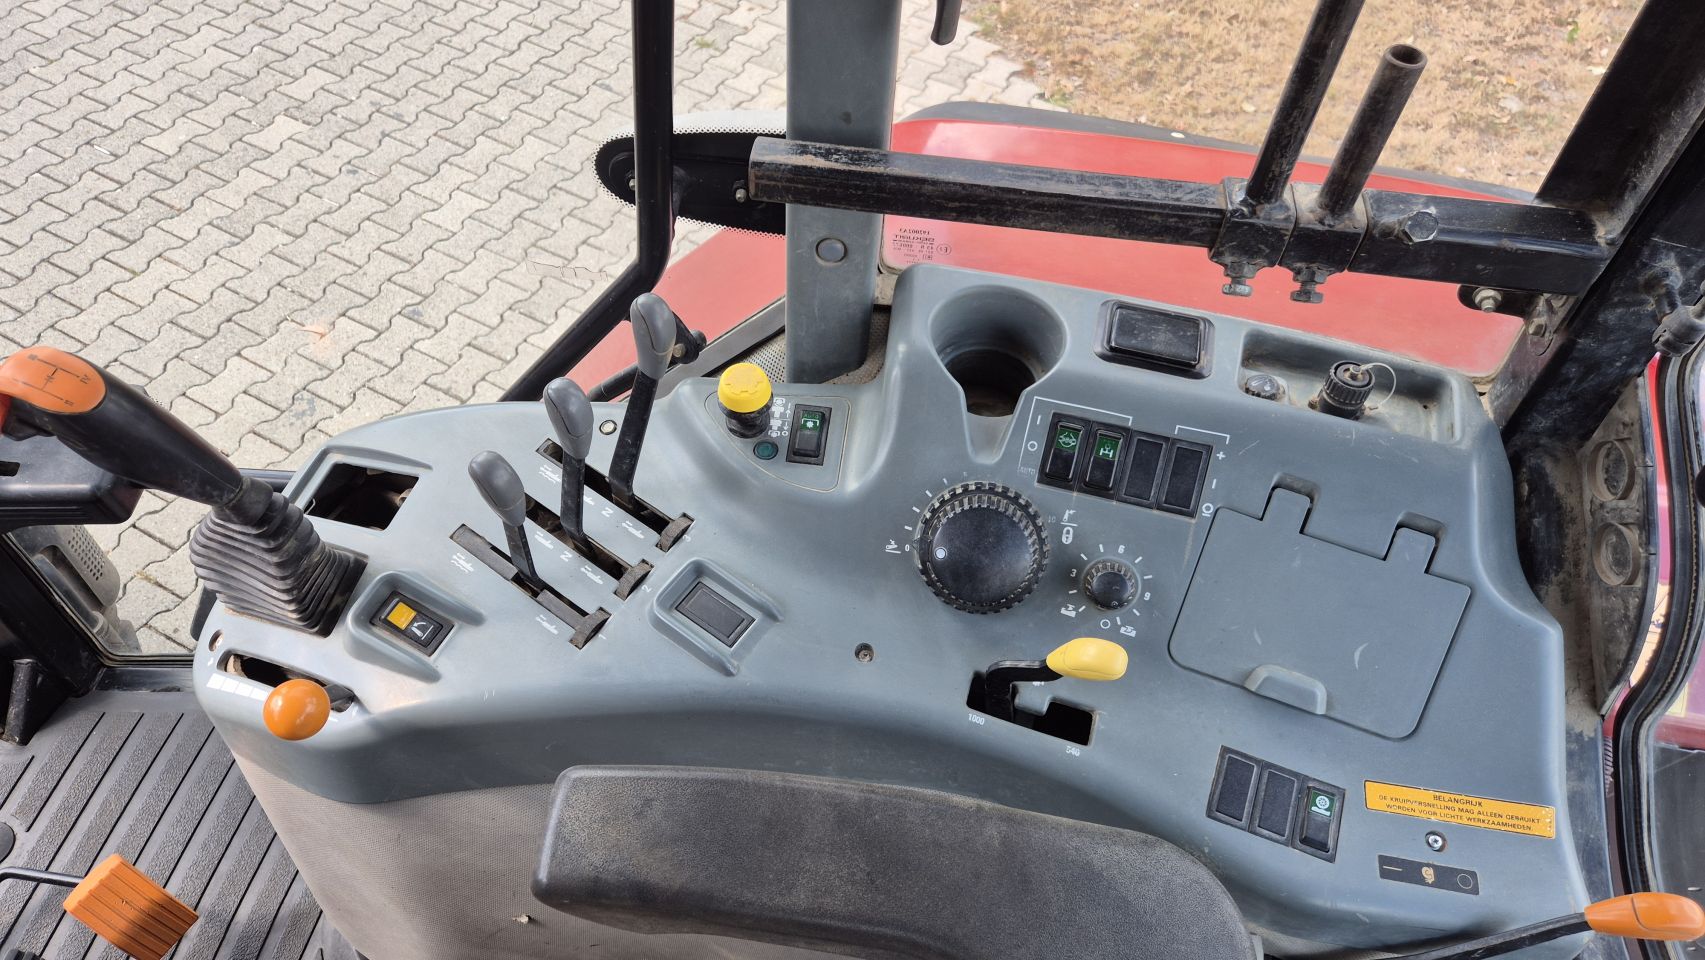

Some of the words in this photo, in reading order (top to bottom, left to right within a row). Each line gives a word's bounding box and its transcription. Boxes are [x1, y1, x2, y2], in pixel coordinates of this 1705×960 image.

[601, 507, 614, 518] N
[1118, 545, 1125, 554] 6
[560, 551, 573, 562] N
[1070, 568, 1077, 578] 3
[1143, 591, 1151, 601] 9
[968, 713, 985, 726] 1000
[1065, 745, 1081, 757] 540
[1433, 794, 1483, 808] BELANGRIJK
[1378, 794, 1388, 802] DE
[1457, 806, 1475, 815] MAG
[1476, 809, 1503, 819] ALLEEN
[1506, 814, 1541, 824] GEBRUIKT
[1385, 803, 1416, 814] WORDEN
[1417, 809, 1438, 817] VOOR
[1439, 811, 1465, 821] LICHTE
